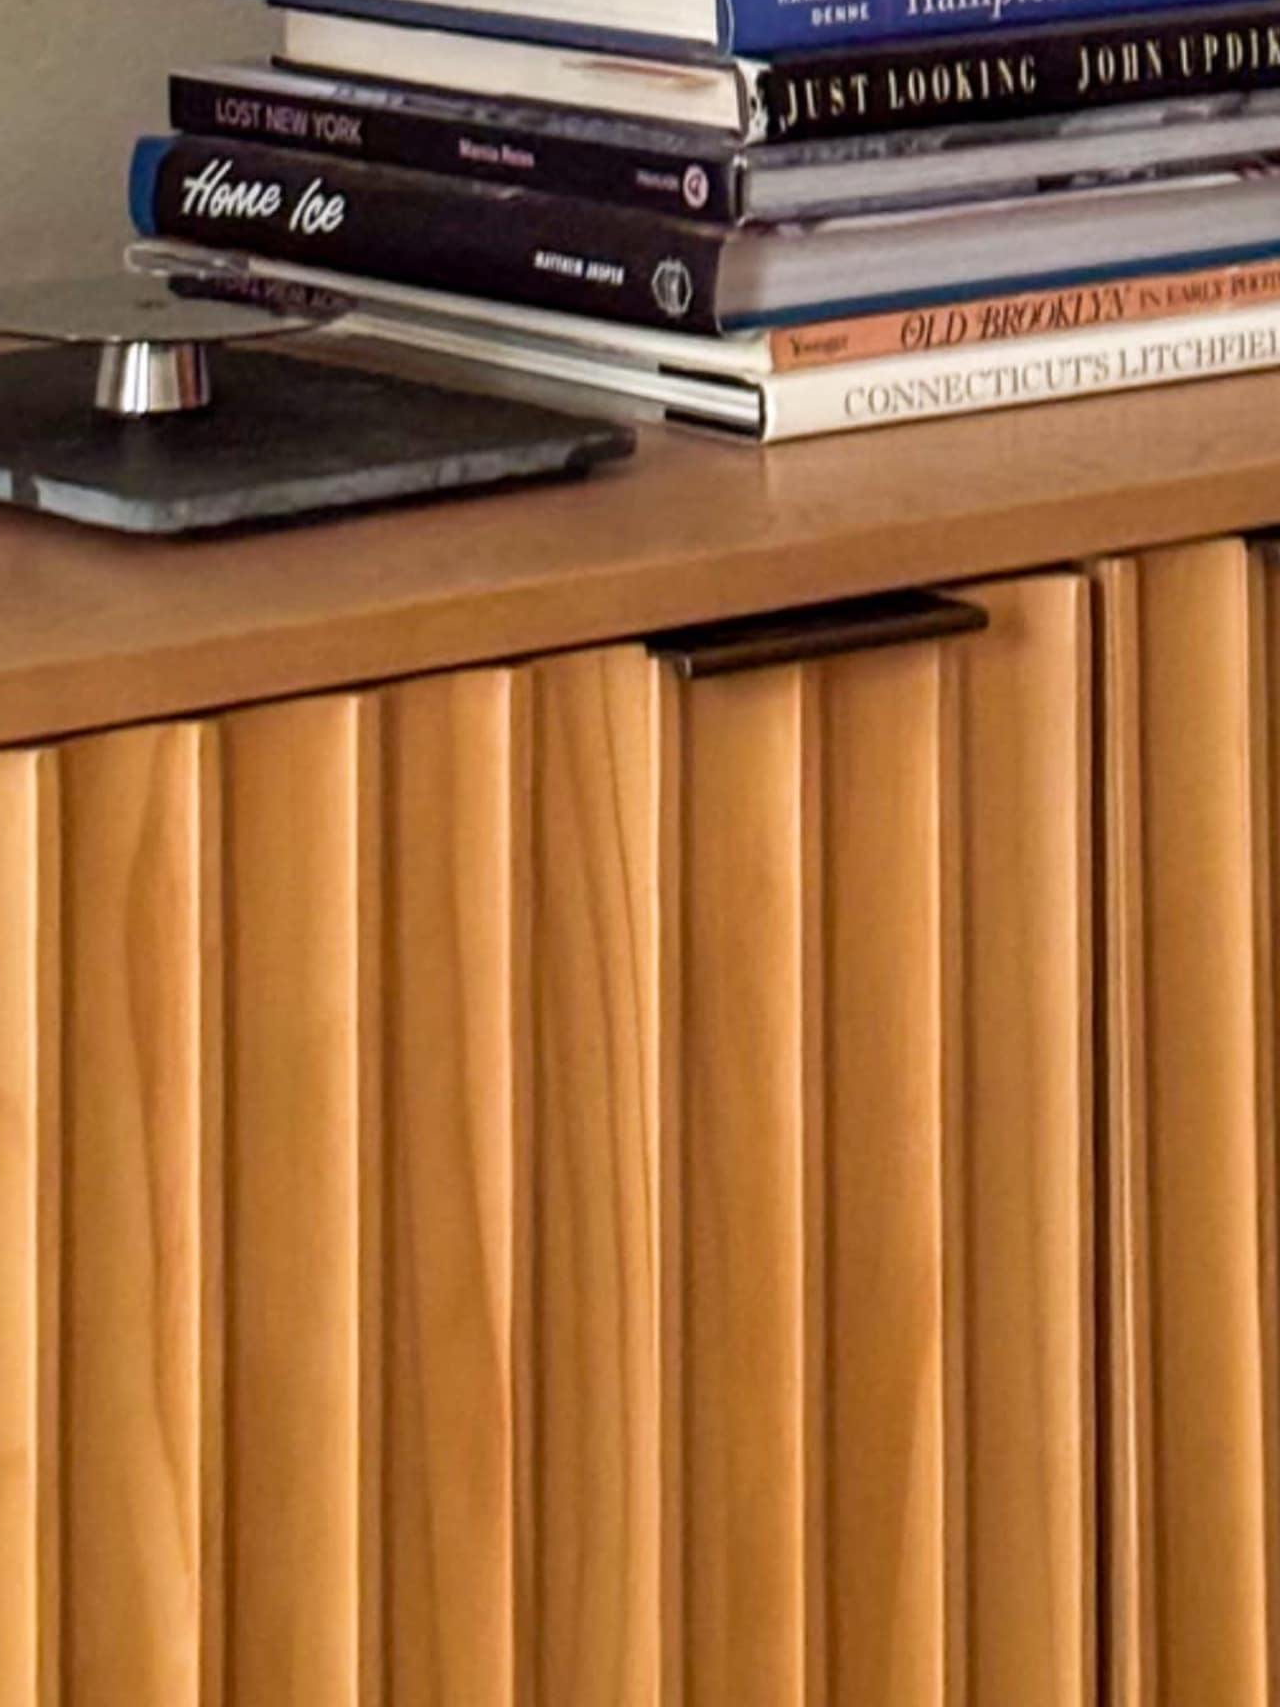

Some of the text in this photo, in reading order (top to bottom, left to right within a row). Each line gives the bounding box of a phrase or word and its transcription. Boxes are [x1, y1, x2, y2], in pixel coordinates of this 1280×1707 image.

[779, 53, 1037, 133] JUST LOOKING
[1078, 38, 1164, 93] JOHN
[214, 98, 363, 145] LOST NEW YORK
[182, 158, 346, 236] Home Ice
[900, 308, 969, 351] OLD
[976, 284, 1132, 340] BROOKLYN
[843, 353, 1111, 418] CONNECTICUT'S
